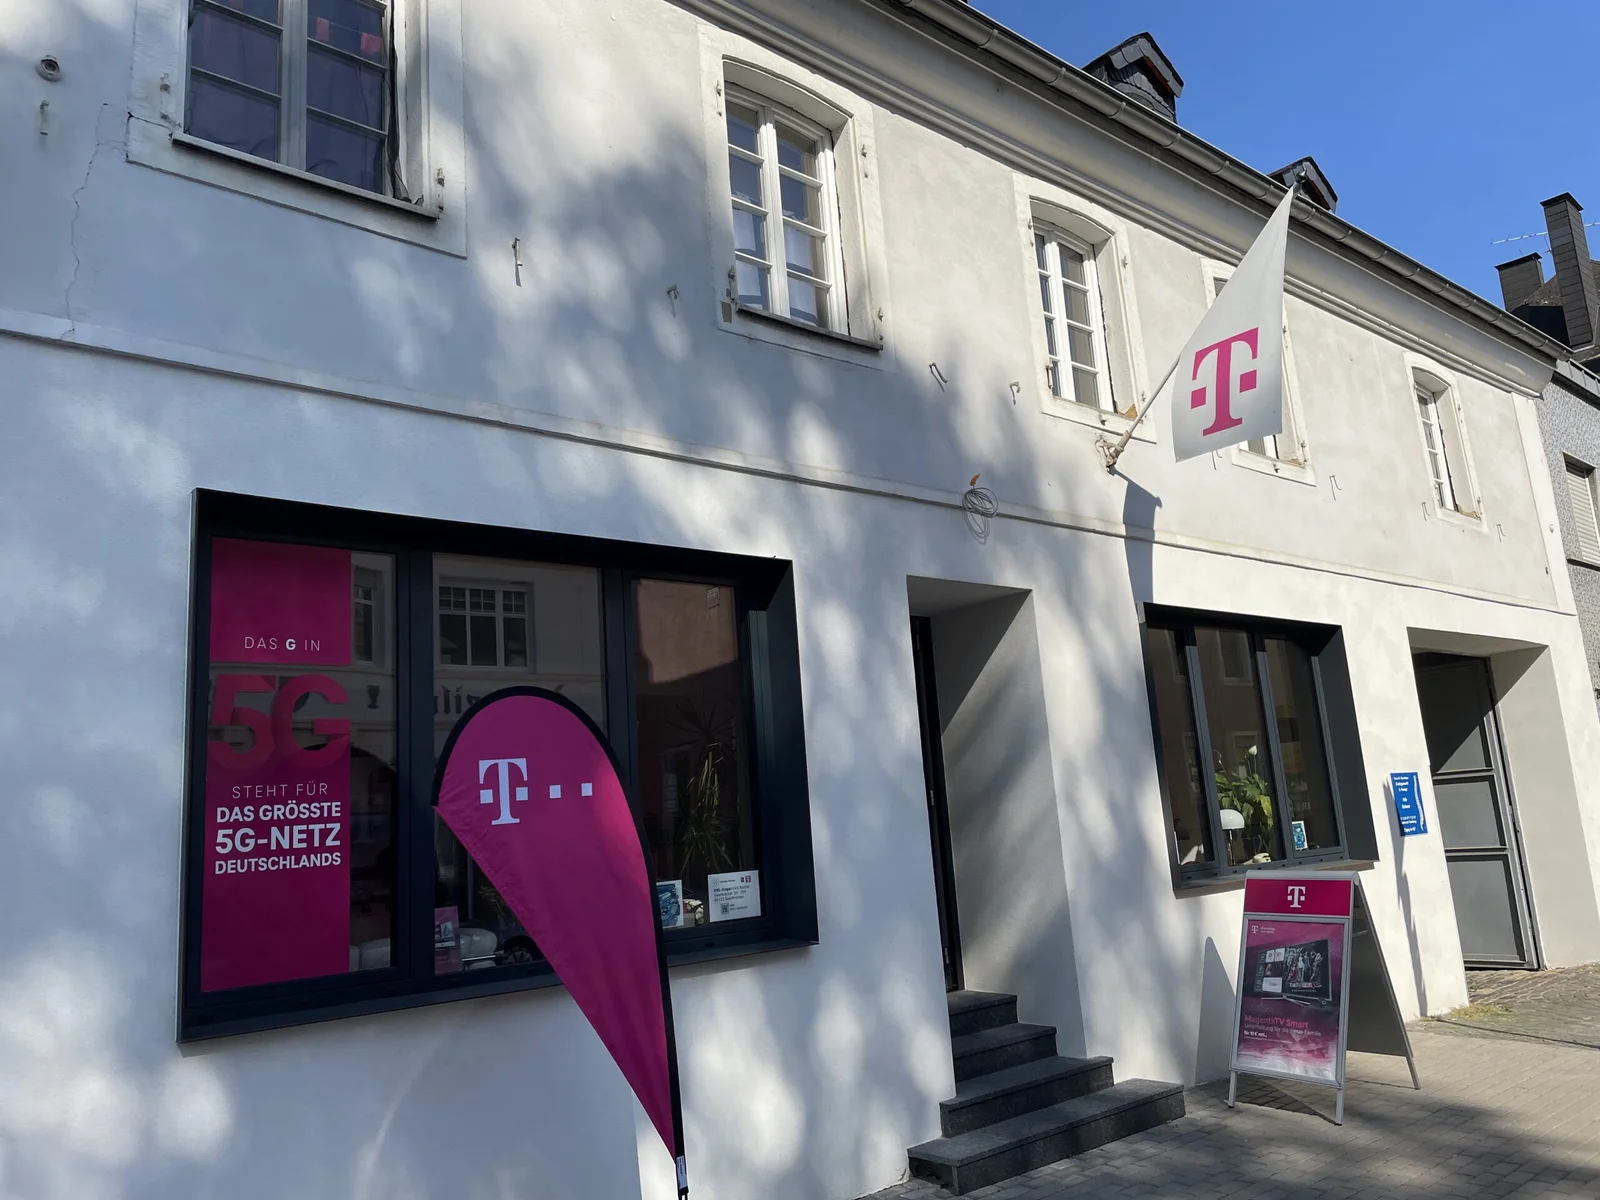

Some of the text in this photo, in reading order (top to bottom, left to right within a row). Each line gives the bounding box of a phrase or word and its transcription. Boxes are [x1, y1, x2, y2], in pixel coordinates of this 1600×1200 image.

[1191, 327, 1258, 436] T
[244, 636, 321, 652] DAS G IN
[207, 673, 351, 771] 5G
[232, 780, 329, 799] STEHT FÜR
[479, 758, 528, 825] T
[216, 800, 341, 823] DAS GRÖSSTE
[215, 822, 341, 854] 5G-NETZ
[215, 852, 341, 875] DEUTSCHLANDS
[1287, 886, 1306, 908] T
[1286, 1019, 1309, 1028] Smart
